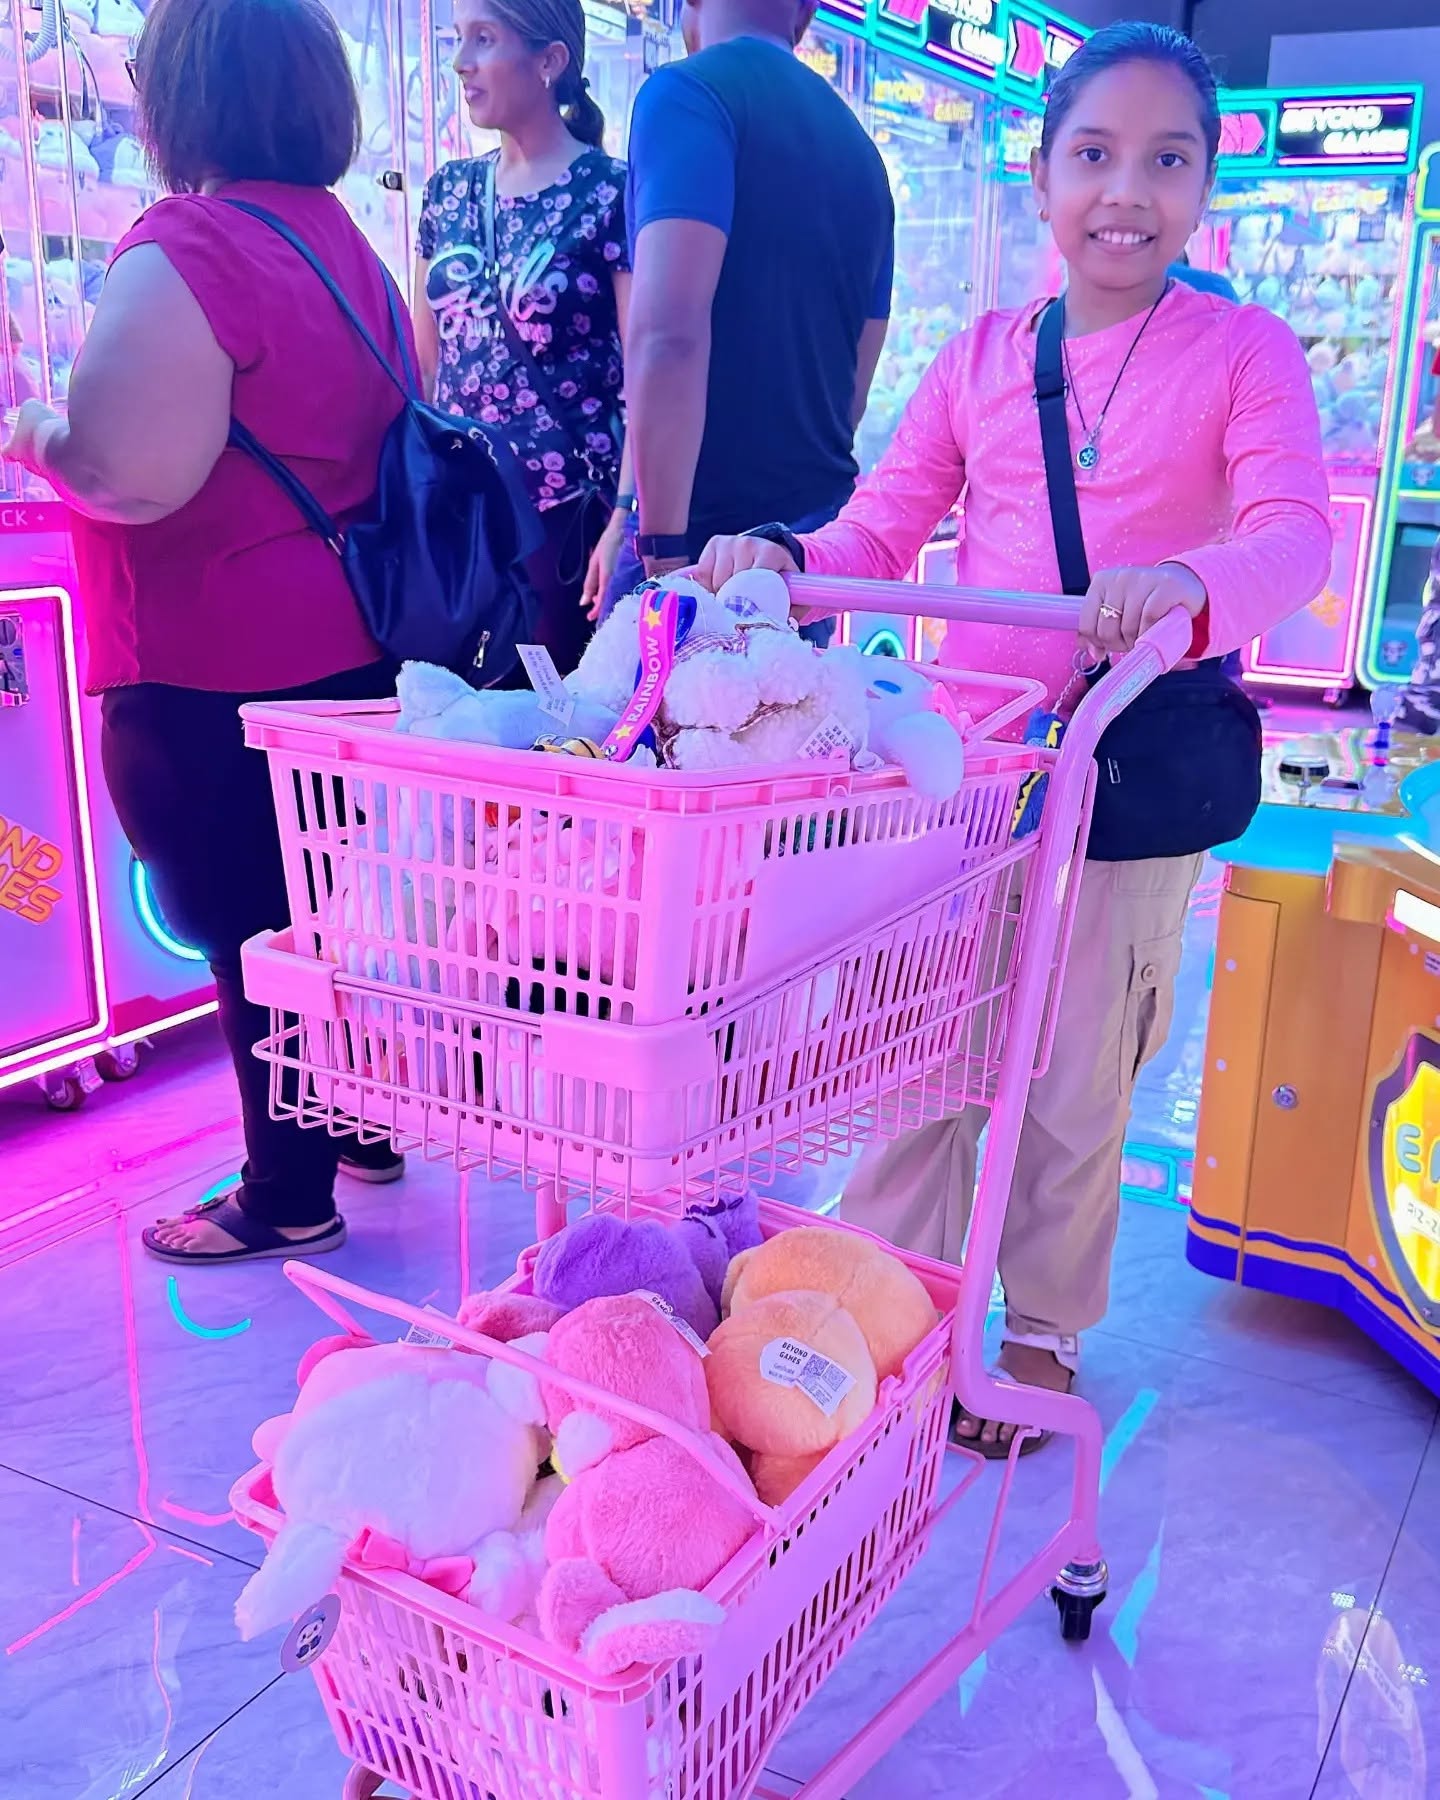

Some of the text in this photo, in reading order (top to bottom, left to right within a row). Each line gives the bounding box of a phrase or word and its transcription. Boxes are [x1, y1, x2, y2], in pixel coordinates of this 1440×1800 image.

[1279, 105, 1383, 134] BEYOND
[1322, 128, 1410, 155] GAMES
[627, 636, 662, 723] RAINBOW
[0, 863, 64, 923] ES
[779, 1351, 802, 1365] GAMES
[781, 1341, 809, 1358] BEYOND
